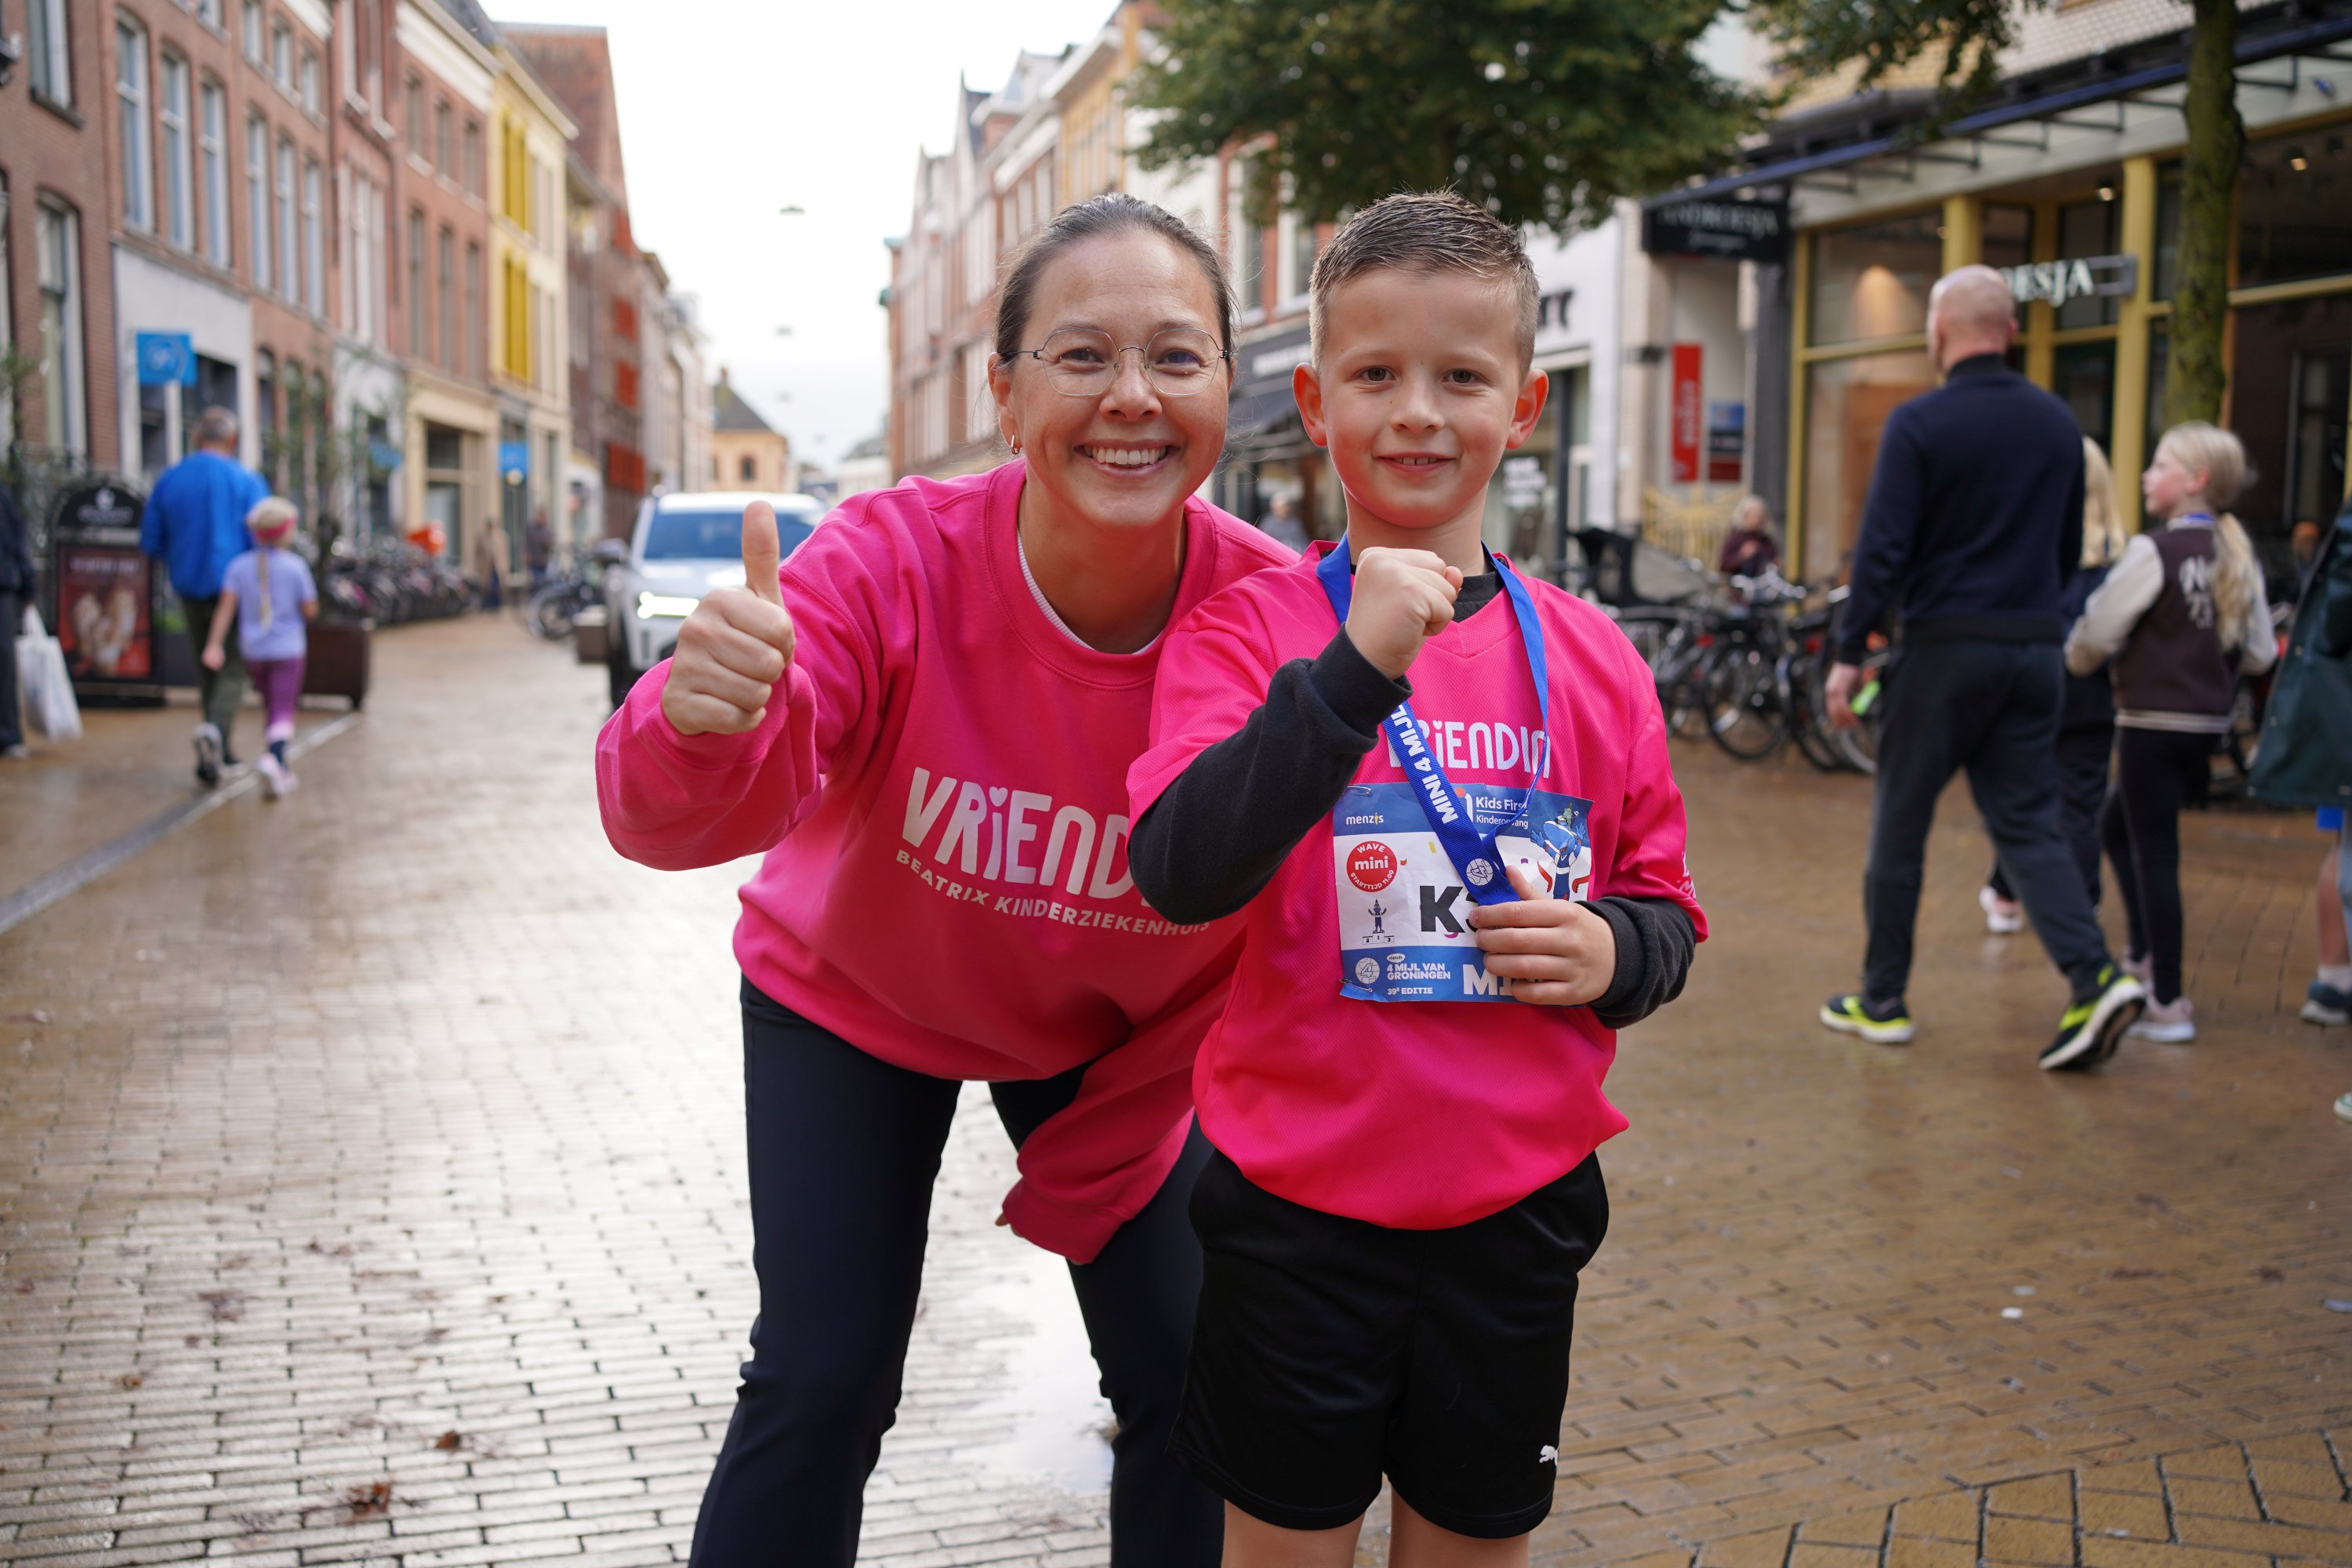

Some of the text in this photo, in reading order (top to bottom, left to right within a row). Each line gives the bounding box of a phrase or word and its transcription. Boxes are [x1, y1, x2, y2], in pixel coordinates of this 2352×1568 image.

[1391, 704, 1458, 824] MINI 4 MIJL
[1475, 797, 1502, 809] Kids
[1345, 812, 1385, 825] menzis
[1357, 843, 1385, 853] WAVE
[1355, 855, 1388, 870] mini
[896, 849, 990, 905] BEATRIX
[1350, 869, 1394, 890] STARTTIJD 11.00
[1395, 963, 1421, 971] MIJL
[1422, 963, 1446, 971] VAN
[1387, 971, 1451, 980] GRONINGEN
